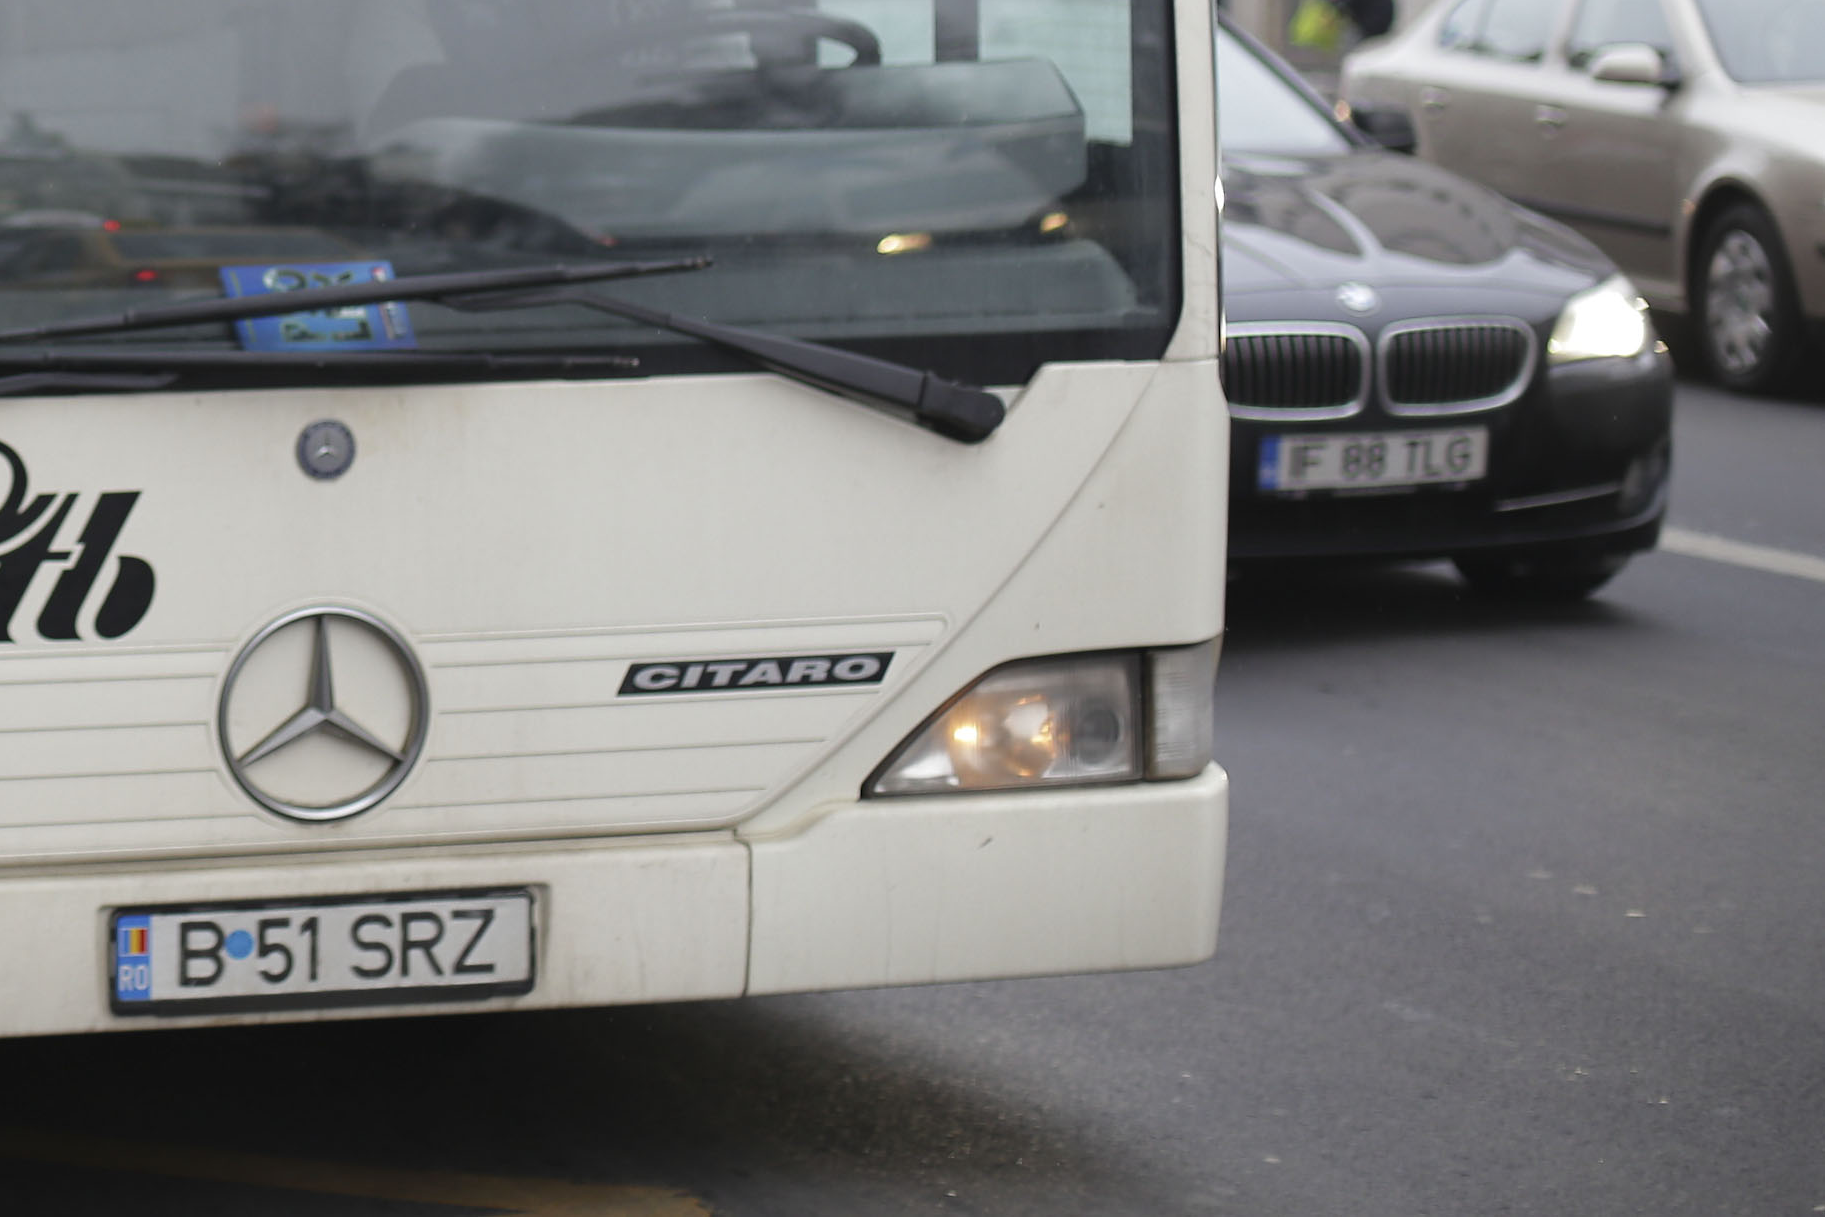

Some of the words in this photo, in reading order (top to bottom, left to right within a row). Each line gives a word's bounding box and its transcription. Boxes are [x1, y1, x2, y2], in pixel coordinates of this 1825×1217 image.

[1341, 441, 1388, 479] 88
[1404, 435, 1472, 476] TLG
[632, 654, 882, 691] CITARO
[178, 920, 226, 987] B
[257, 915, 321, 984] 51
[349, 908, 497, 980] SRZ
[118, 964, 150, 992] RO
